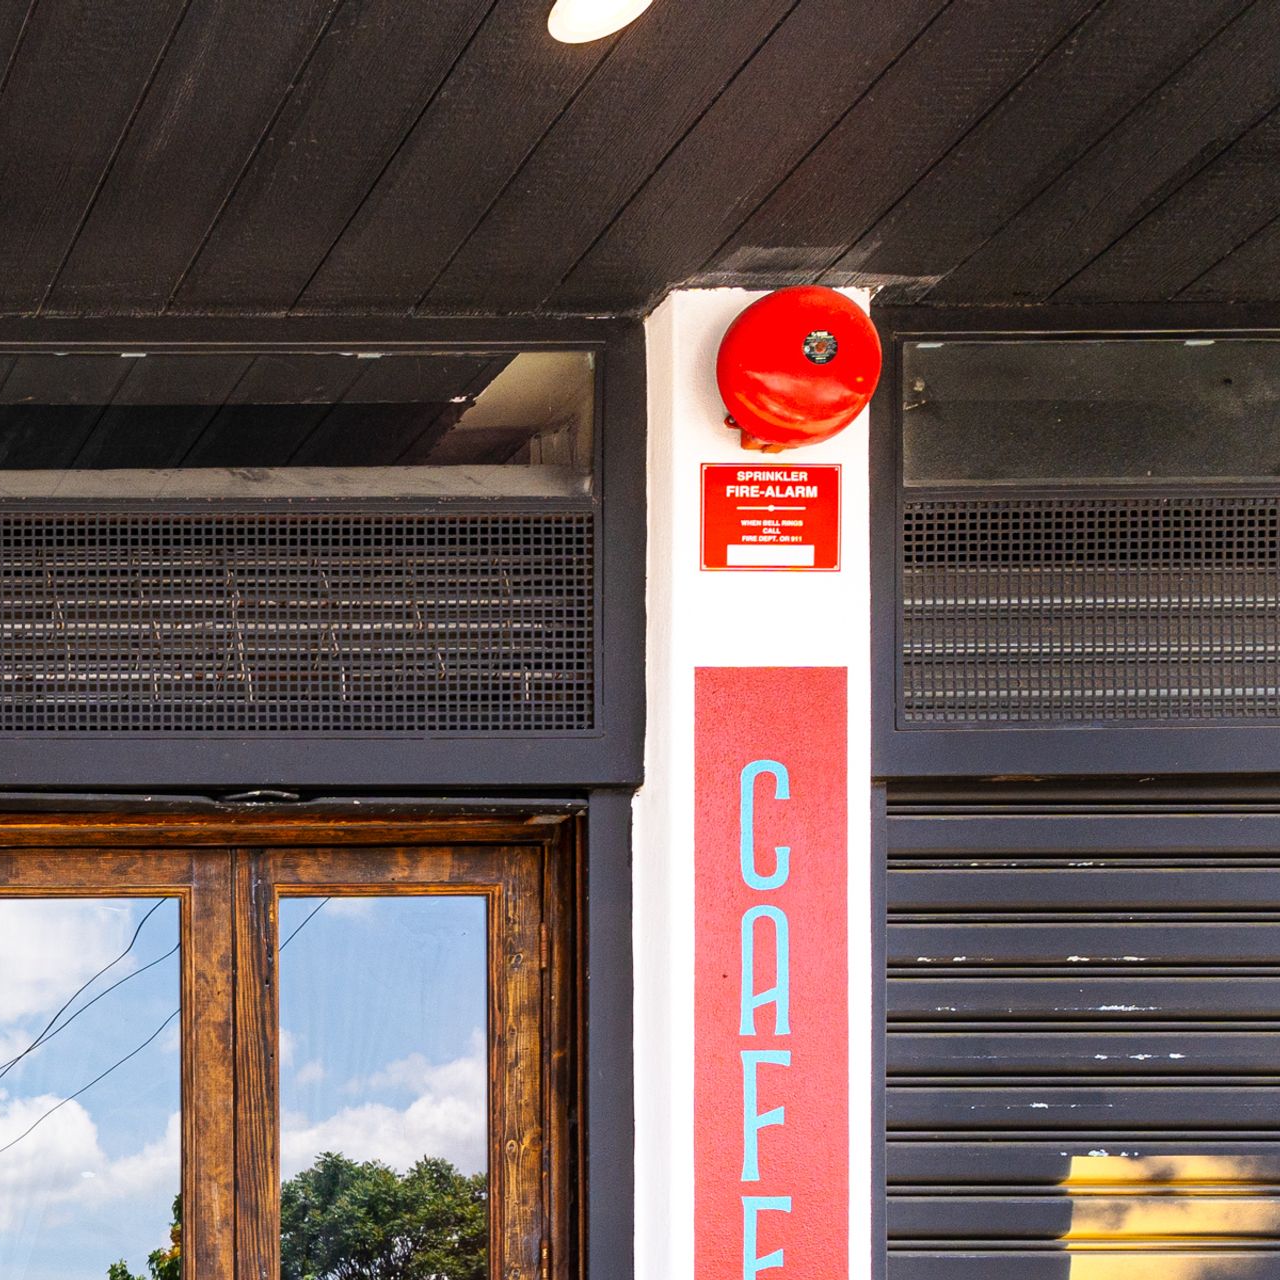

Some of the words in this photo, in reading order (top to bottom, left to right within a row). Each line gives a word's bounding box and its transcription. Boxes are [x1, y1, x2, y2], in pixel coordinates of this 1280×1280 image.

[737, 471, 808, 481] SPRINKLER
[726, 485, 818, 498] FIRE-ALARM
[741, 519, 762, 527] WHEN
[762, 519, 781, 527] BELL
[781, 519, 804, 527] RINGS
[762, 527, 782, 535] CALL
